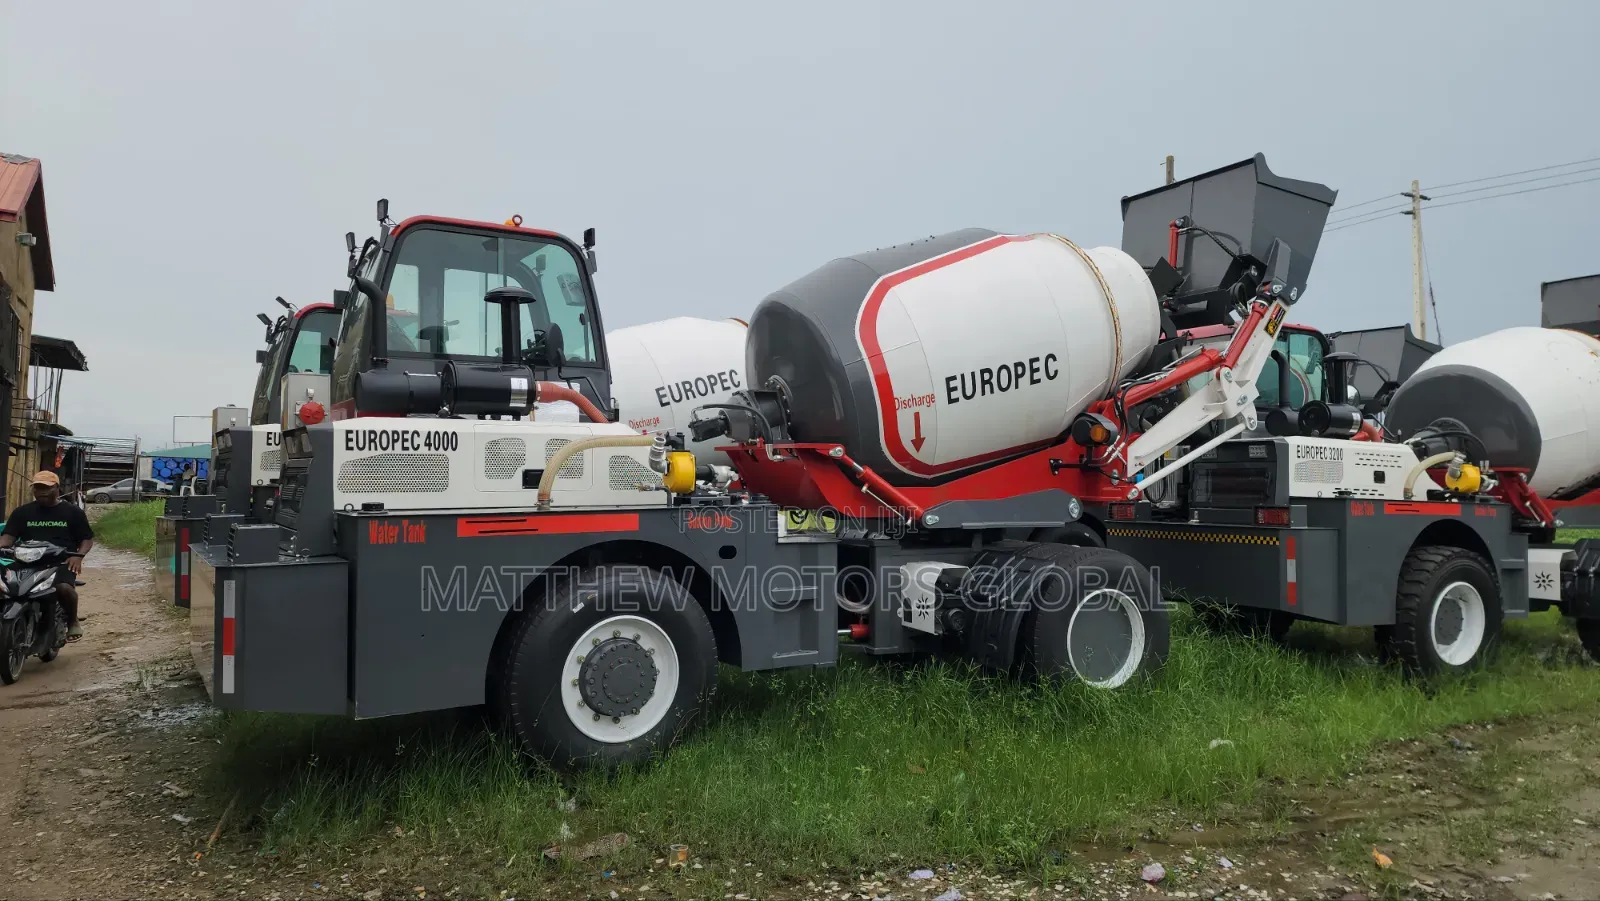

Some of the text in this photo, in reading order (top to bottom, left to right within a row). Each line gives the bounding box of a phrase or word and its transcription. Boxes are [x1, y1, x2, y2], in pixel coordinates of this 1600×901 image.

[655, 369, 741, 407] EUROPEC
[945, 353, 1058, 405] EUROPEC
[894, 392, 936, 411] Discharge
[628, 416, 660, 429] Discharge
[345, 429, 458, 451] EUROPEC 4000
[1296, 444, 1344, 461] EUROPEC 3200
[369, 519, 426, 544] Water Tank
